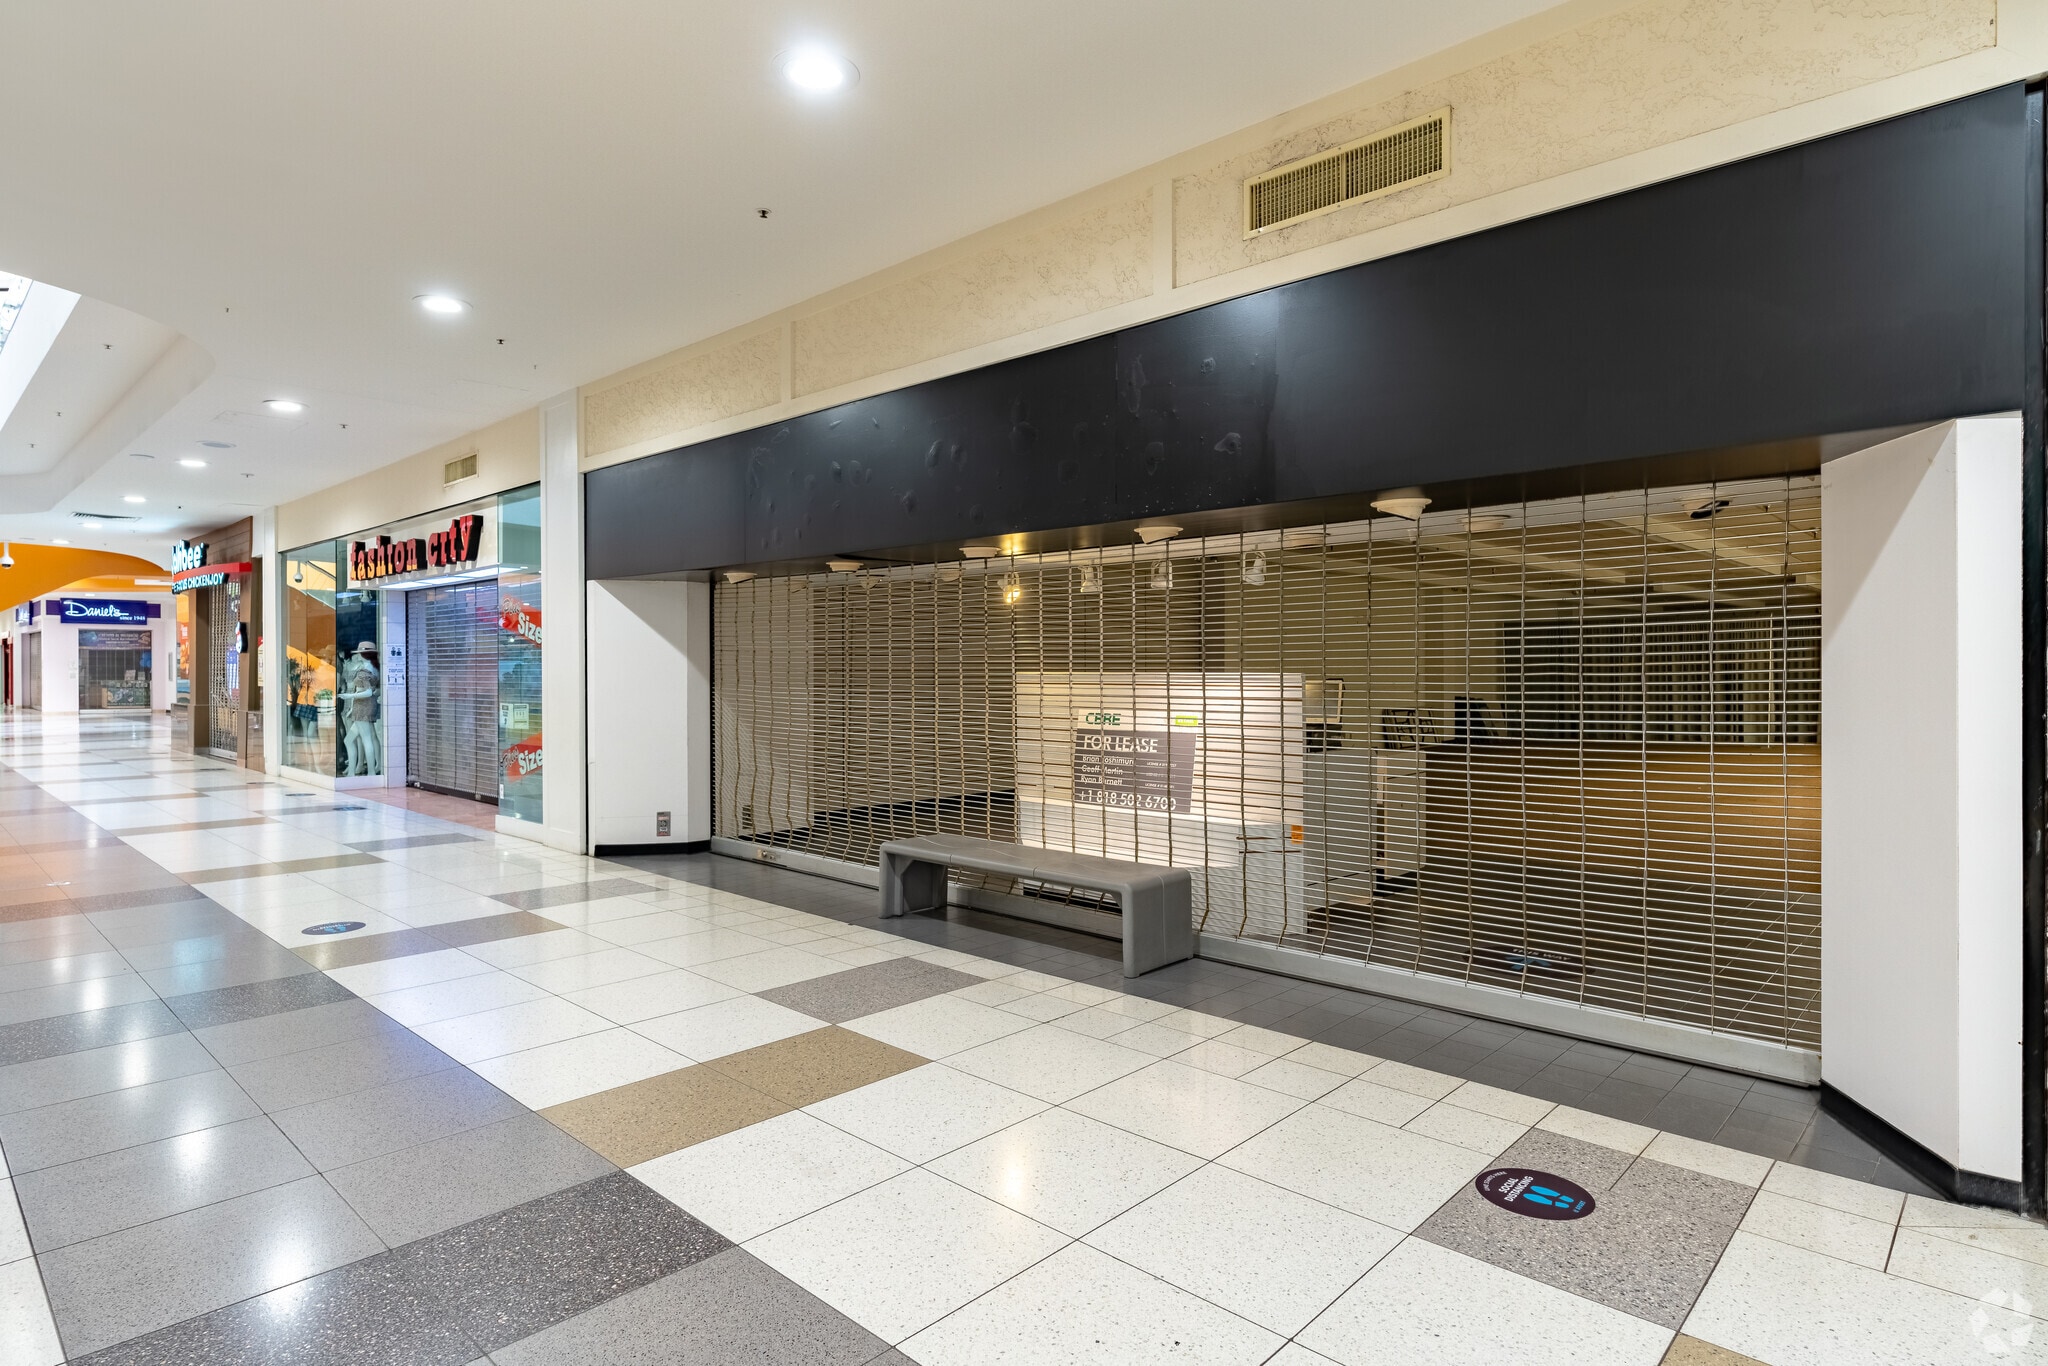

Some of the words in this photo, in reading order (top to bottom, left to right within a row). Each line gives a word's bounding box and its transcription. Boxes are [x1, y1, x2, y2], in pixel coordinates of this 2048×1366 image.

[350, 536, 419, 581] fashion
[428, 515, 480, 566] city
[188, 572, 225, 589] CHICKENJOY
[63, 600, 129, 617] Daniel's
[1085, 712, 1121, 726] CBRE
[1083, 735, 1112, 751] FOR
[1115, 737, 1159, 753] LEASE
[1096, 791, 1117, 805] 818
[1120, 793, 1142, 807] 502
[1145, 795, 1177, 811] 6700
[1498, 1177, 1519, 1194] SOCIAL
[1503, 1175, 1534, 1202] DISTANCING
